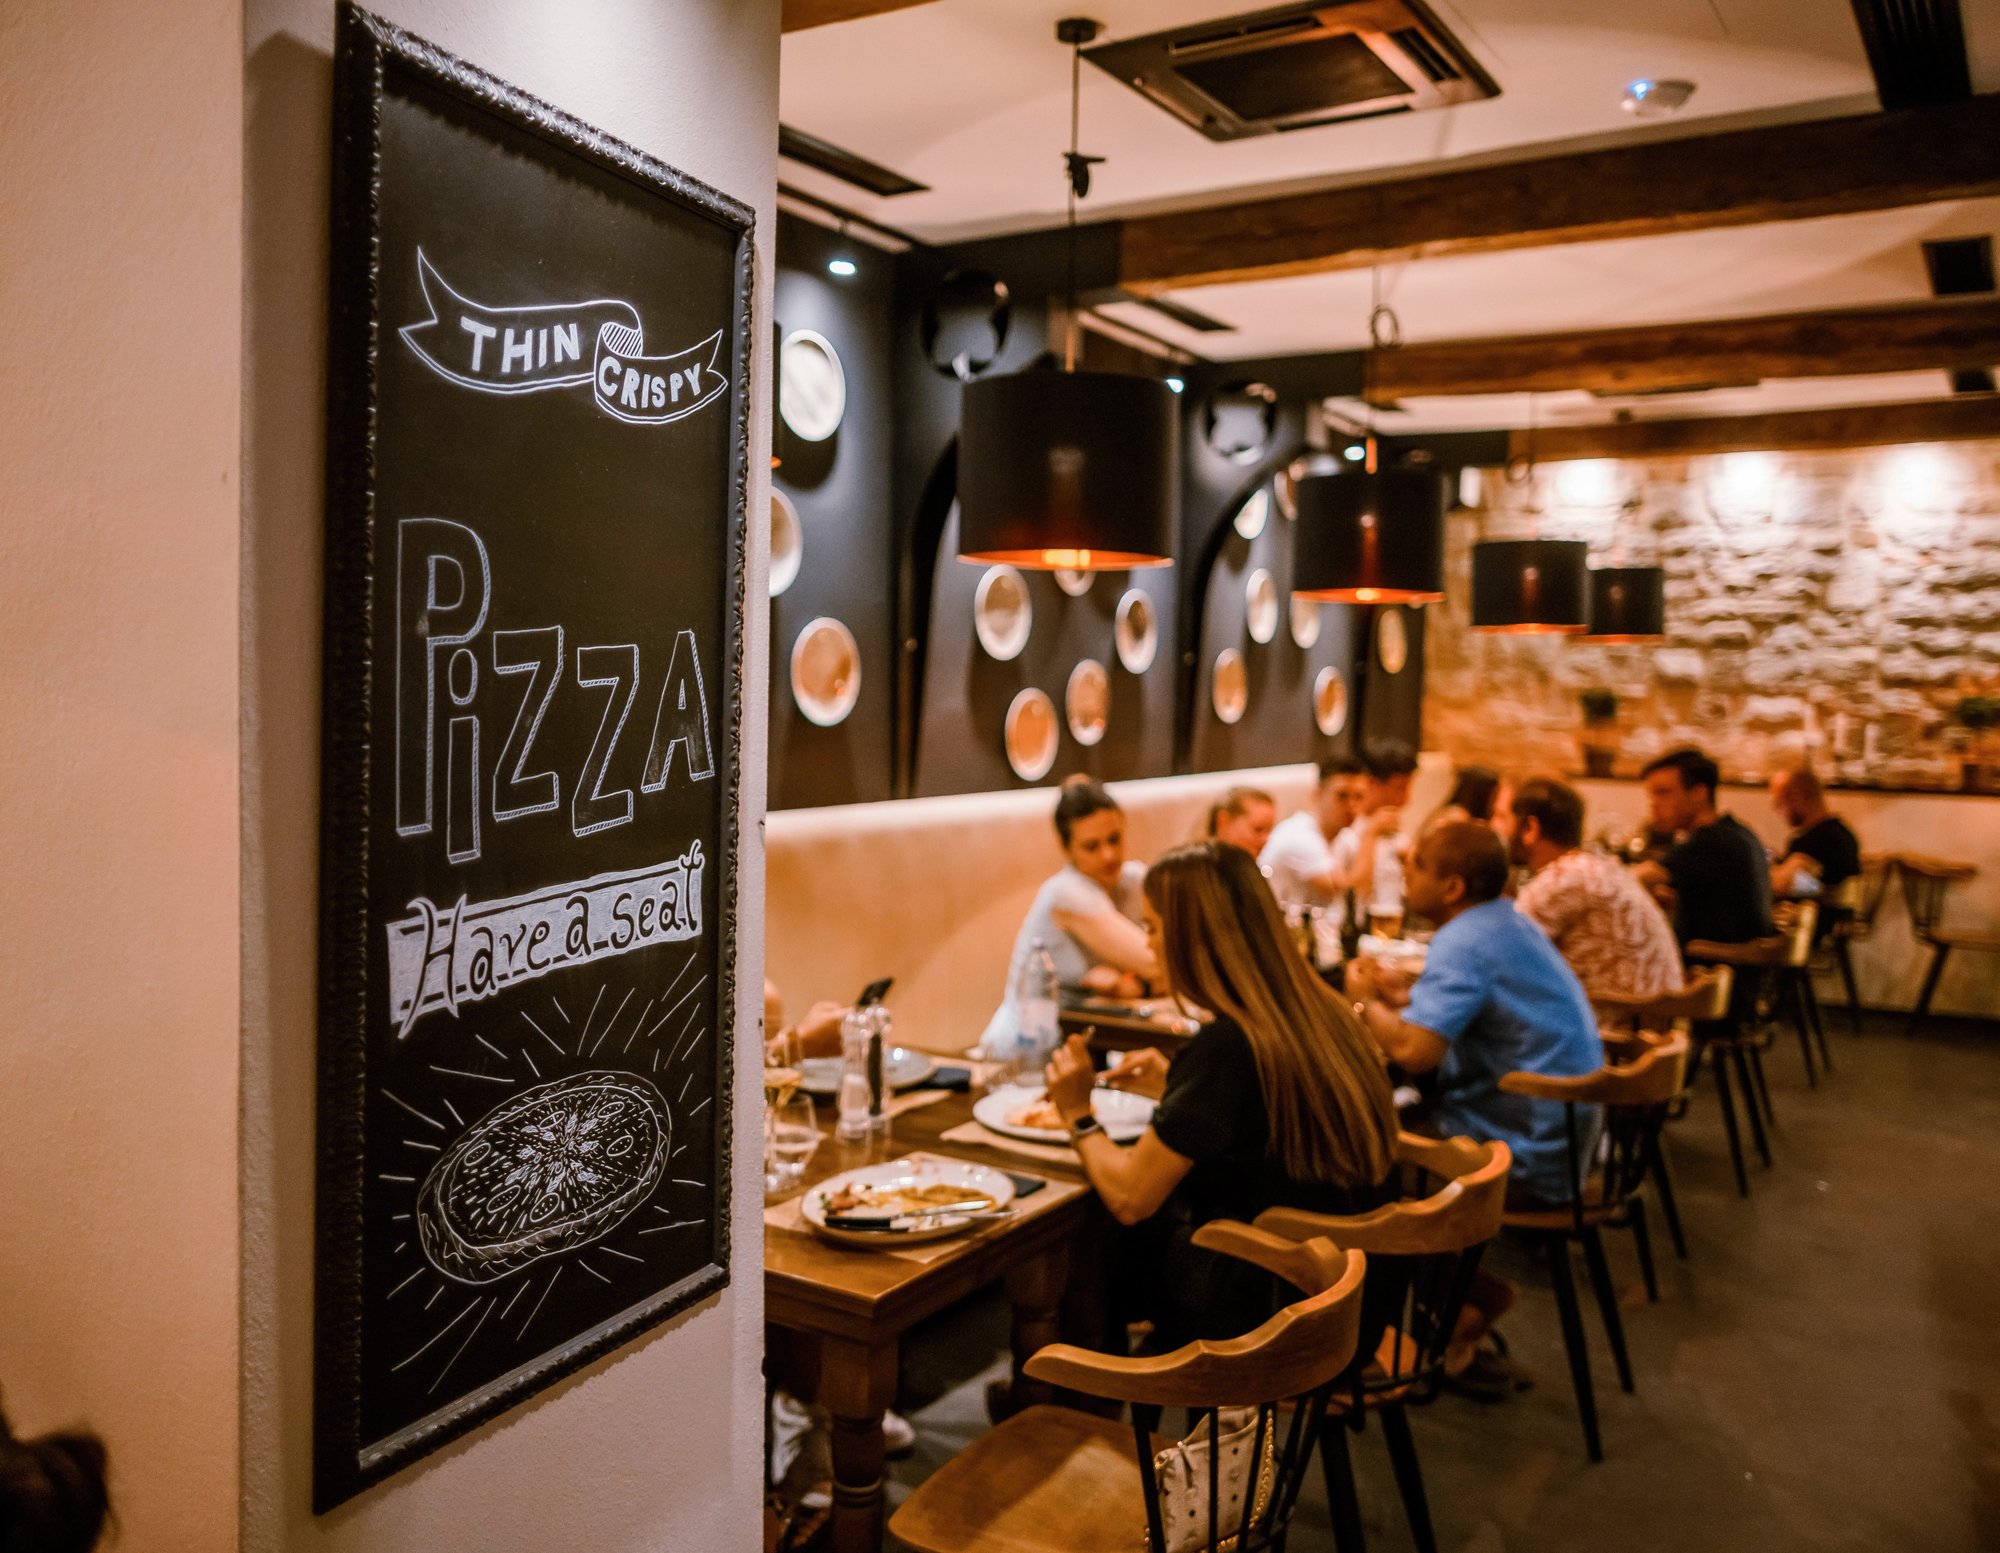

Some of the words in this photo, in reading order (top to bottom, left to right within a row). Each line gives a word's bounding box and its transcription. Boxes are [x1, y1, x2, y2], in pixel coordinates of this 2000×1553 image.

[460, 316, 580, 373] THIN
[599, 356, 701, 408] CRISPY
[398, 893, 551, 1040] Have
[565, 894, 592, 956] a
[610, 839, 705, 951] seat
